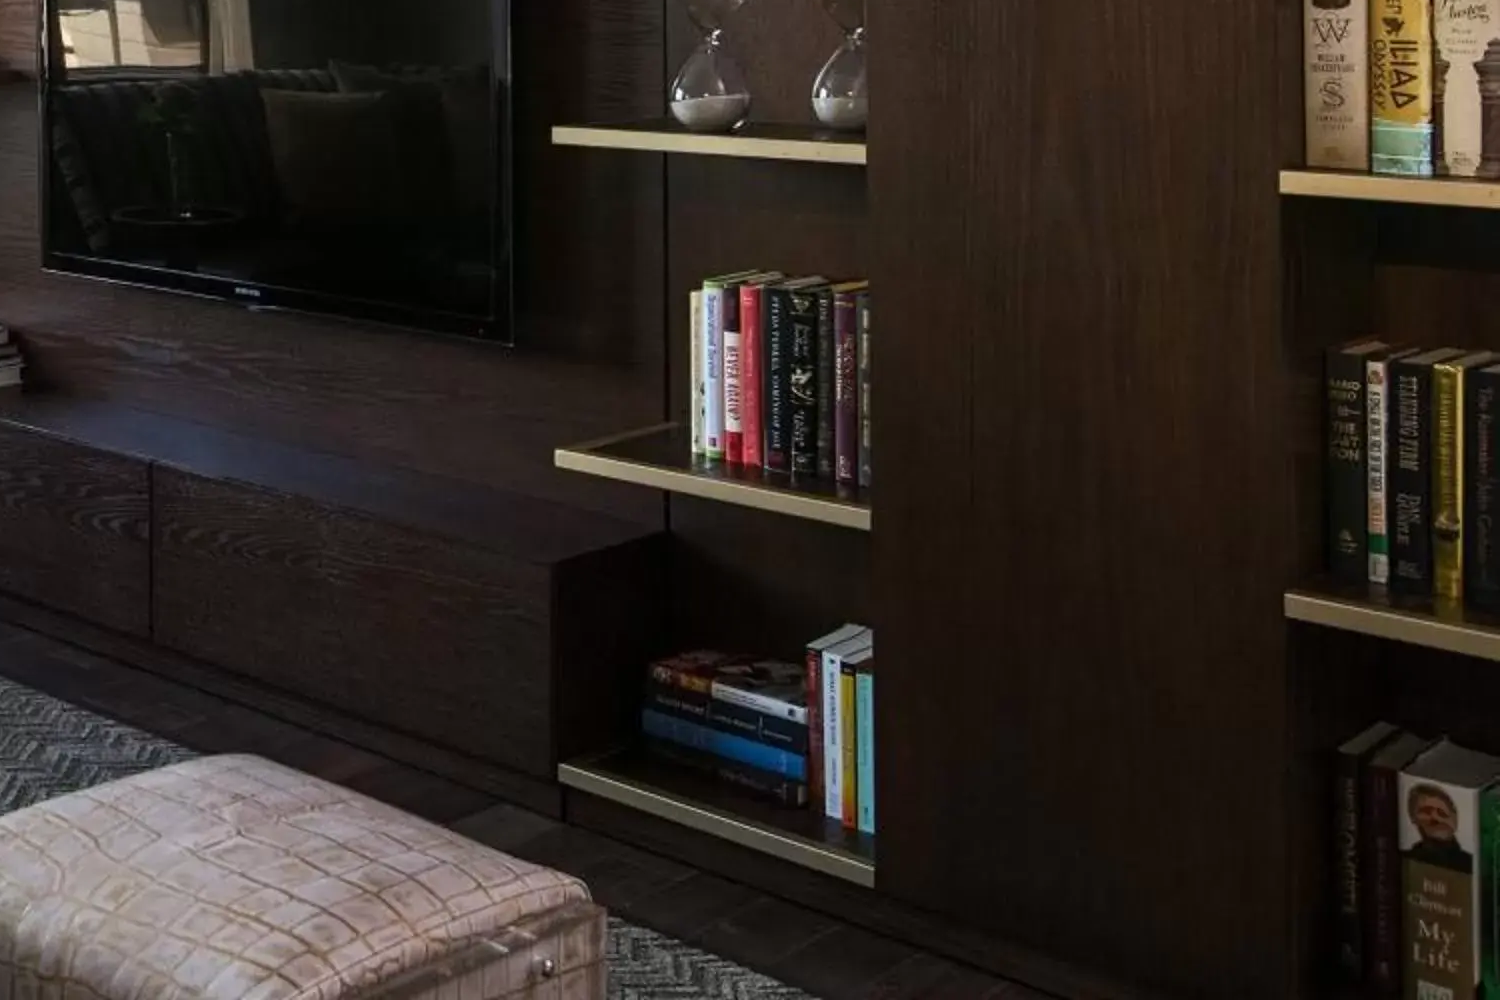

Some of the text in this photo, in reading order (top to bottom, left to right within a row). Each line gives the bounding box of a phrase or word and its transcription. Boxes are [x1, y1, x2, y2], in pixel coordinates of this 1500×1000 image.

[1389, 39, 1419, 109] ILIAD
[1418, 919, 1456, 946] My
[1412, 943, 1461, 973] Life
